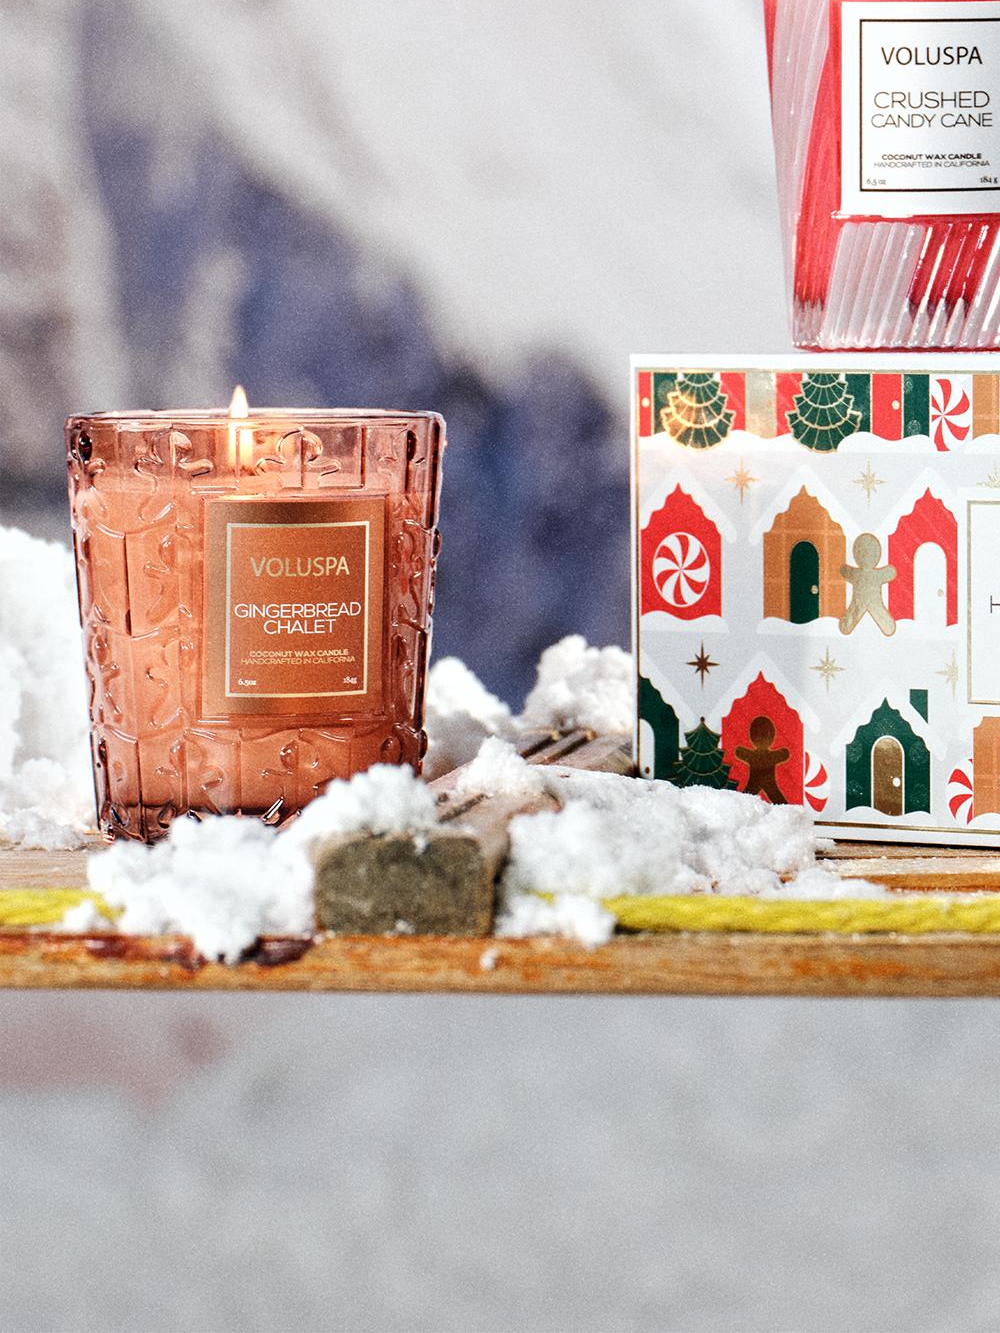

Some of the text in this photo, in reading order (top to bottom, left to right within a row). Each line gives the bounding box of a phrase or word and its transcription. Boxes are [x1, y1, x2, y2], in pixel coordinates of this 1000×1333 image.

[881, 46, 983, 66] VOLUSPA
[873, 91, 990, 109] CRUSHED
[871, 112, 993, 129] CANDY CANE
[947, 152, 983, 160] CANDLE
[250, 555, 350, 578] VOLUSPA
[234, 601, 361, 619] GINGERBREAD
[263, 619, 336, 635] CHALET
[249, 648, 349, 659] COCONUT WAX CANDLE
[312, 656, 356, 664] CALIFORNIA
